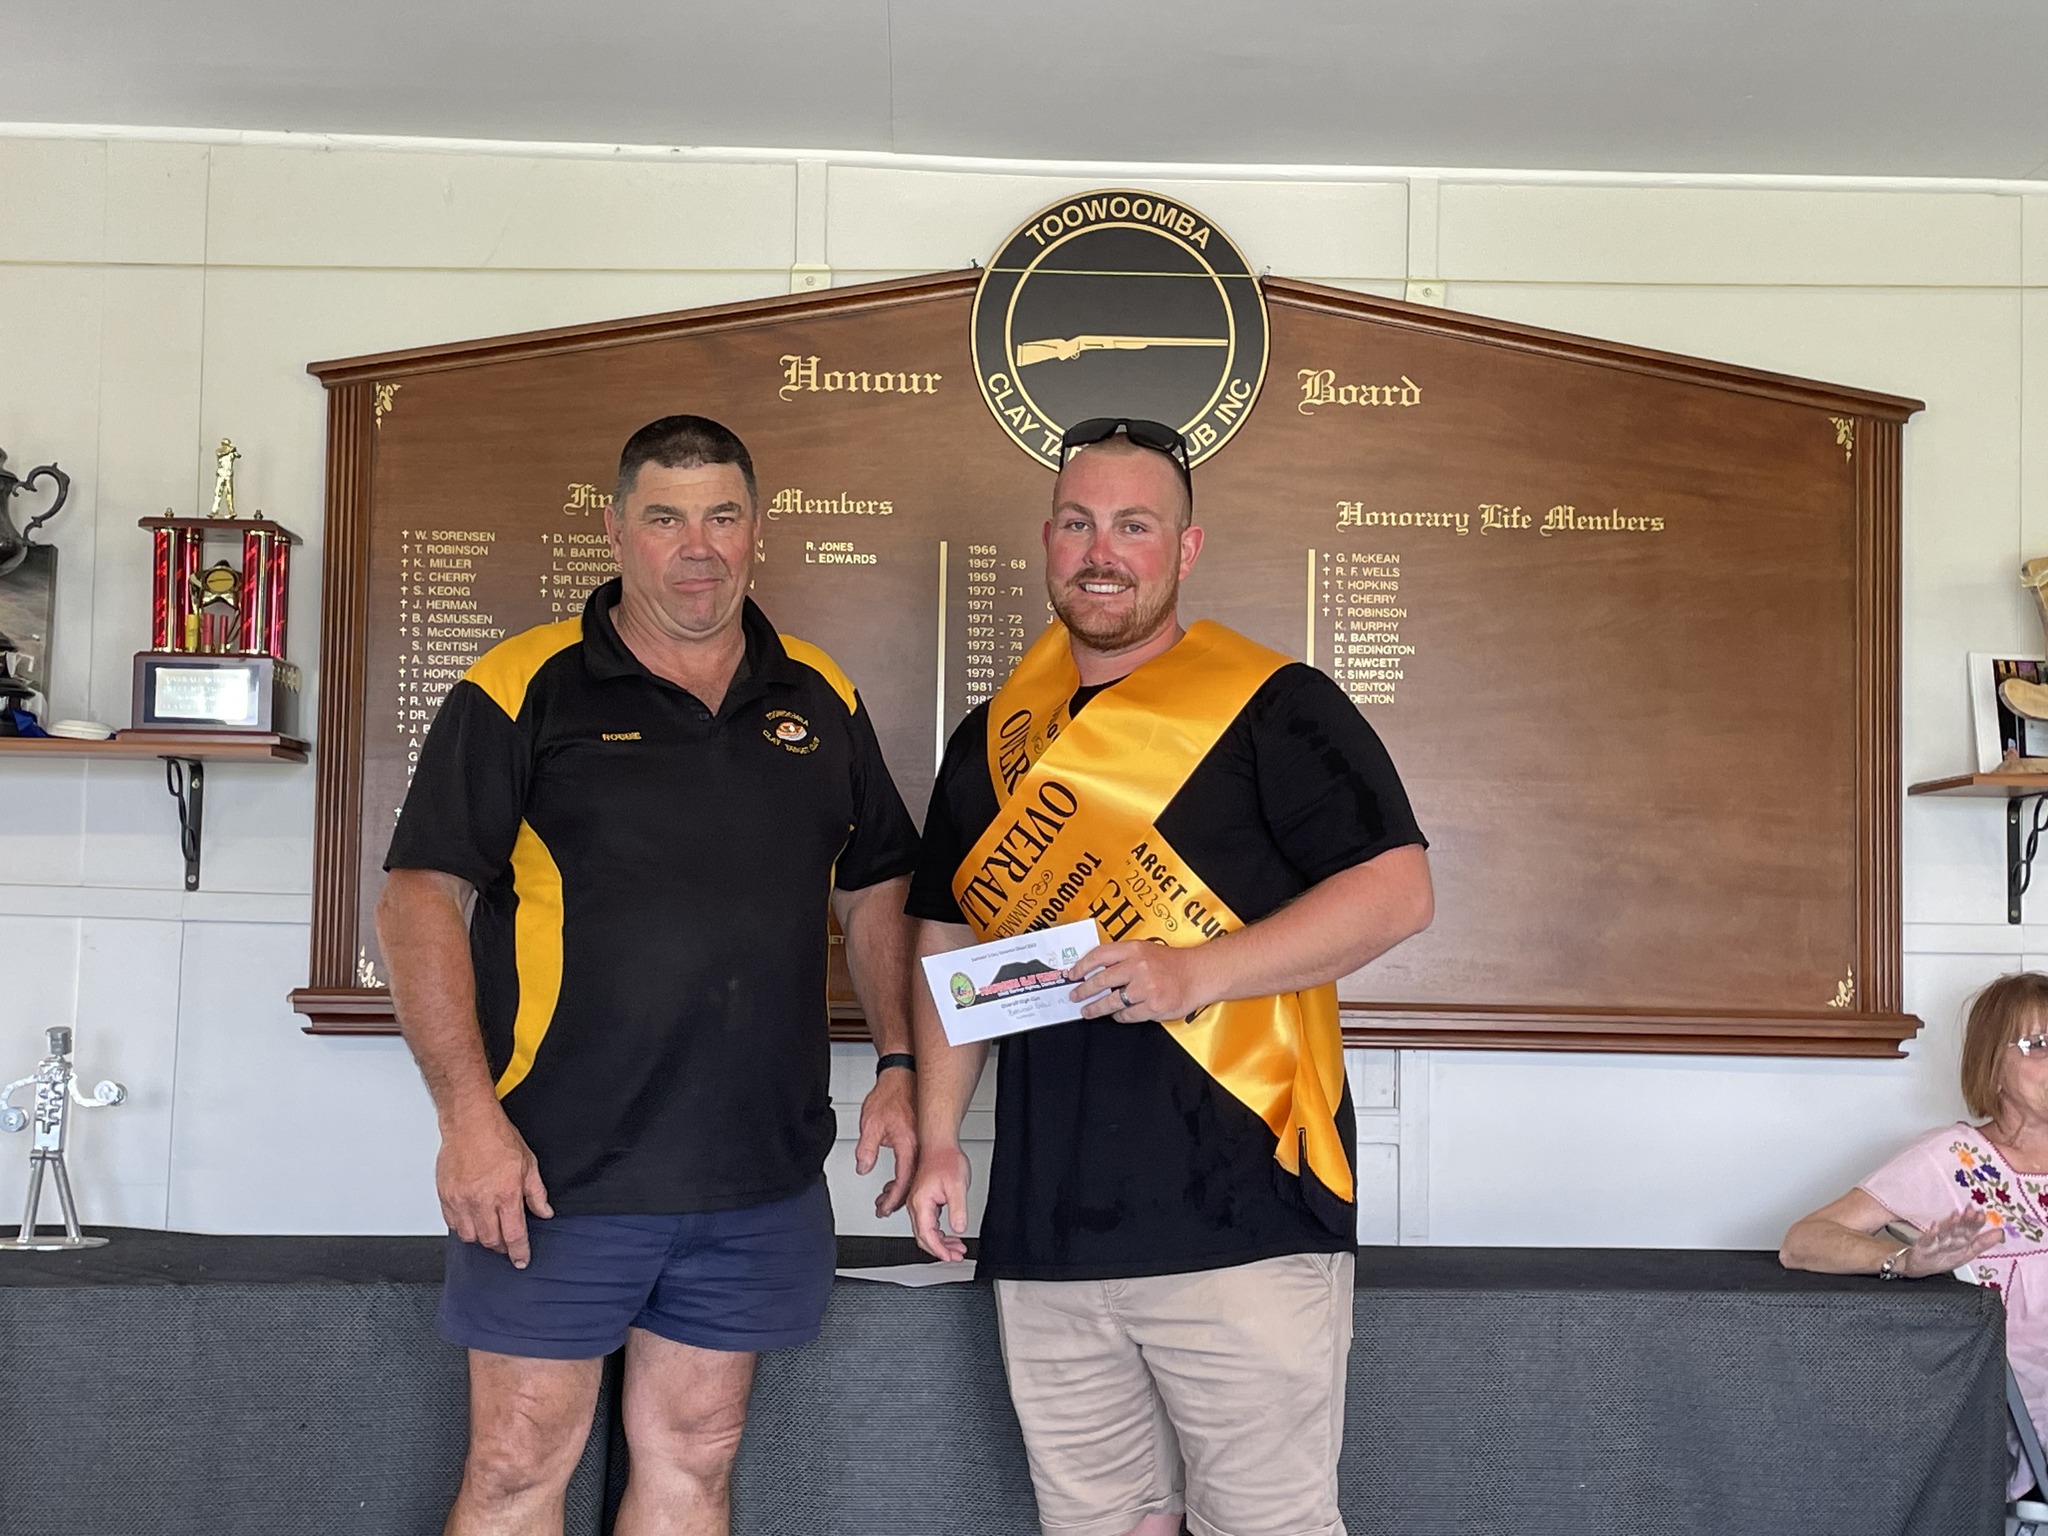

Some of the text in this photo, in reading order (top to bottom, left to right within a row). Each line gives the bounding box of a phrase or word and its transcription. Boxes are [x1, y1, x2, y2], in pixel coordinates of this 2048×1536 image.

[1025, 197, 1212, 250] TOOWOOMBA
[778, 355, 1423, 415] Honour Board
[987, 371, 1041, 436] CLAY
[1213, 378, 1252, 427] INC
[767, 488, 894, 521] Members
[1335, 501, 1666, 538] Honorary Life Members
[415, 530, 496, 542] W. SORENSEN
[553, 533, 564, 544] D.
[414, 543, 489, 556] T. ROBINSON
[805, 541, 854, 552] R. JONES
[967, 544, 997, 556] 1966
[552, 547, 566, 558] M.
[413, 558, 472, 569] K. MILLER
[805, 553, 878, 565] L. EDWARDS
[967, 558, 997, 569] 1967
[1010, 559, 1028, 570] 68
[1335, 553, 1401, 564] G. McKEAN
[566, 561, 624, 573] CONNORS
[1335, 566, 1401, 578] R. F. WELLS
[413, 572, 477, 583] C. CHERRY
[552, 575, 573, 585] SIR
[967, 572, 997, 582] 1969
[413, 585, 471, 597] S. KEONG
[1335, 580, 1399, 591] T. HOPKINS
[553, 589, 566, 599] W.
[967, 586, 996, 596] 1970
[1009, 586, 1025, 597] 71
[1335, 594, 1397, 604] C. CHERRY
[412, 599, 478, 611] J. HERMAN
[551, 602, 586, 613] D. GE
[967, 600, 994, 610] 1971
[1335, 607, 1407, 618] T. ROBINSON
[411, 613, 493, 625] B. ASMUSSEN
[967, 613, 994, 624] 1971
[1007, 614, 1023, 625] 72
[1334, 621, 1399, 632] K. MURPHY
[411, 626, 506, 639] S. McCOMISKEY
[967, 627, 995, 637] 1972
[1009, 627, 1025, 638] 73
[1334, 633, 1399, 643] M. BARTON
[411, 641, 478, 652] S. KENTISH
[966, 640, 995, 651] 1973
[1009, 641, 1023, 651] 74
[1334, 645, 1415, 655] D. BEDINGTON
[411, 654, 423, 665] A.
[966, 654, 993, 665] 1974
[1334, 657, 1401, 668] E. FAWCETT
[410, 668, 419, 679] T.
[966, 668, 995, 678] 1979
[1334, 670, 1404, 680] K. SIMPSON
[409, 682, 418, 693] F.
[966, 682, 993, 692] 1981
[1349, 682, 1396, 692] DENTON
[409, 696, 422, 706] R.
[1350, 695, 1395, 704] DENTON
[409, 709, 430, 720] DR.
[408, 723, 419, 734] J.
[999, 709, 1032, 796] OVER
[960, 780, 1079, 932] OVERALL
[1023, 851, 1103, 935] TOOWOOM
[1125, 870, 1159, 908] 2023
[1060, 946, 1080, 959] ACTA
